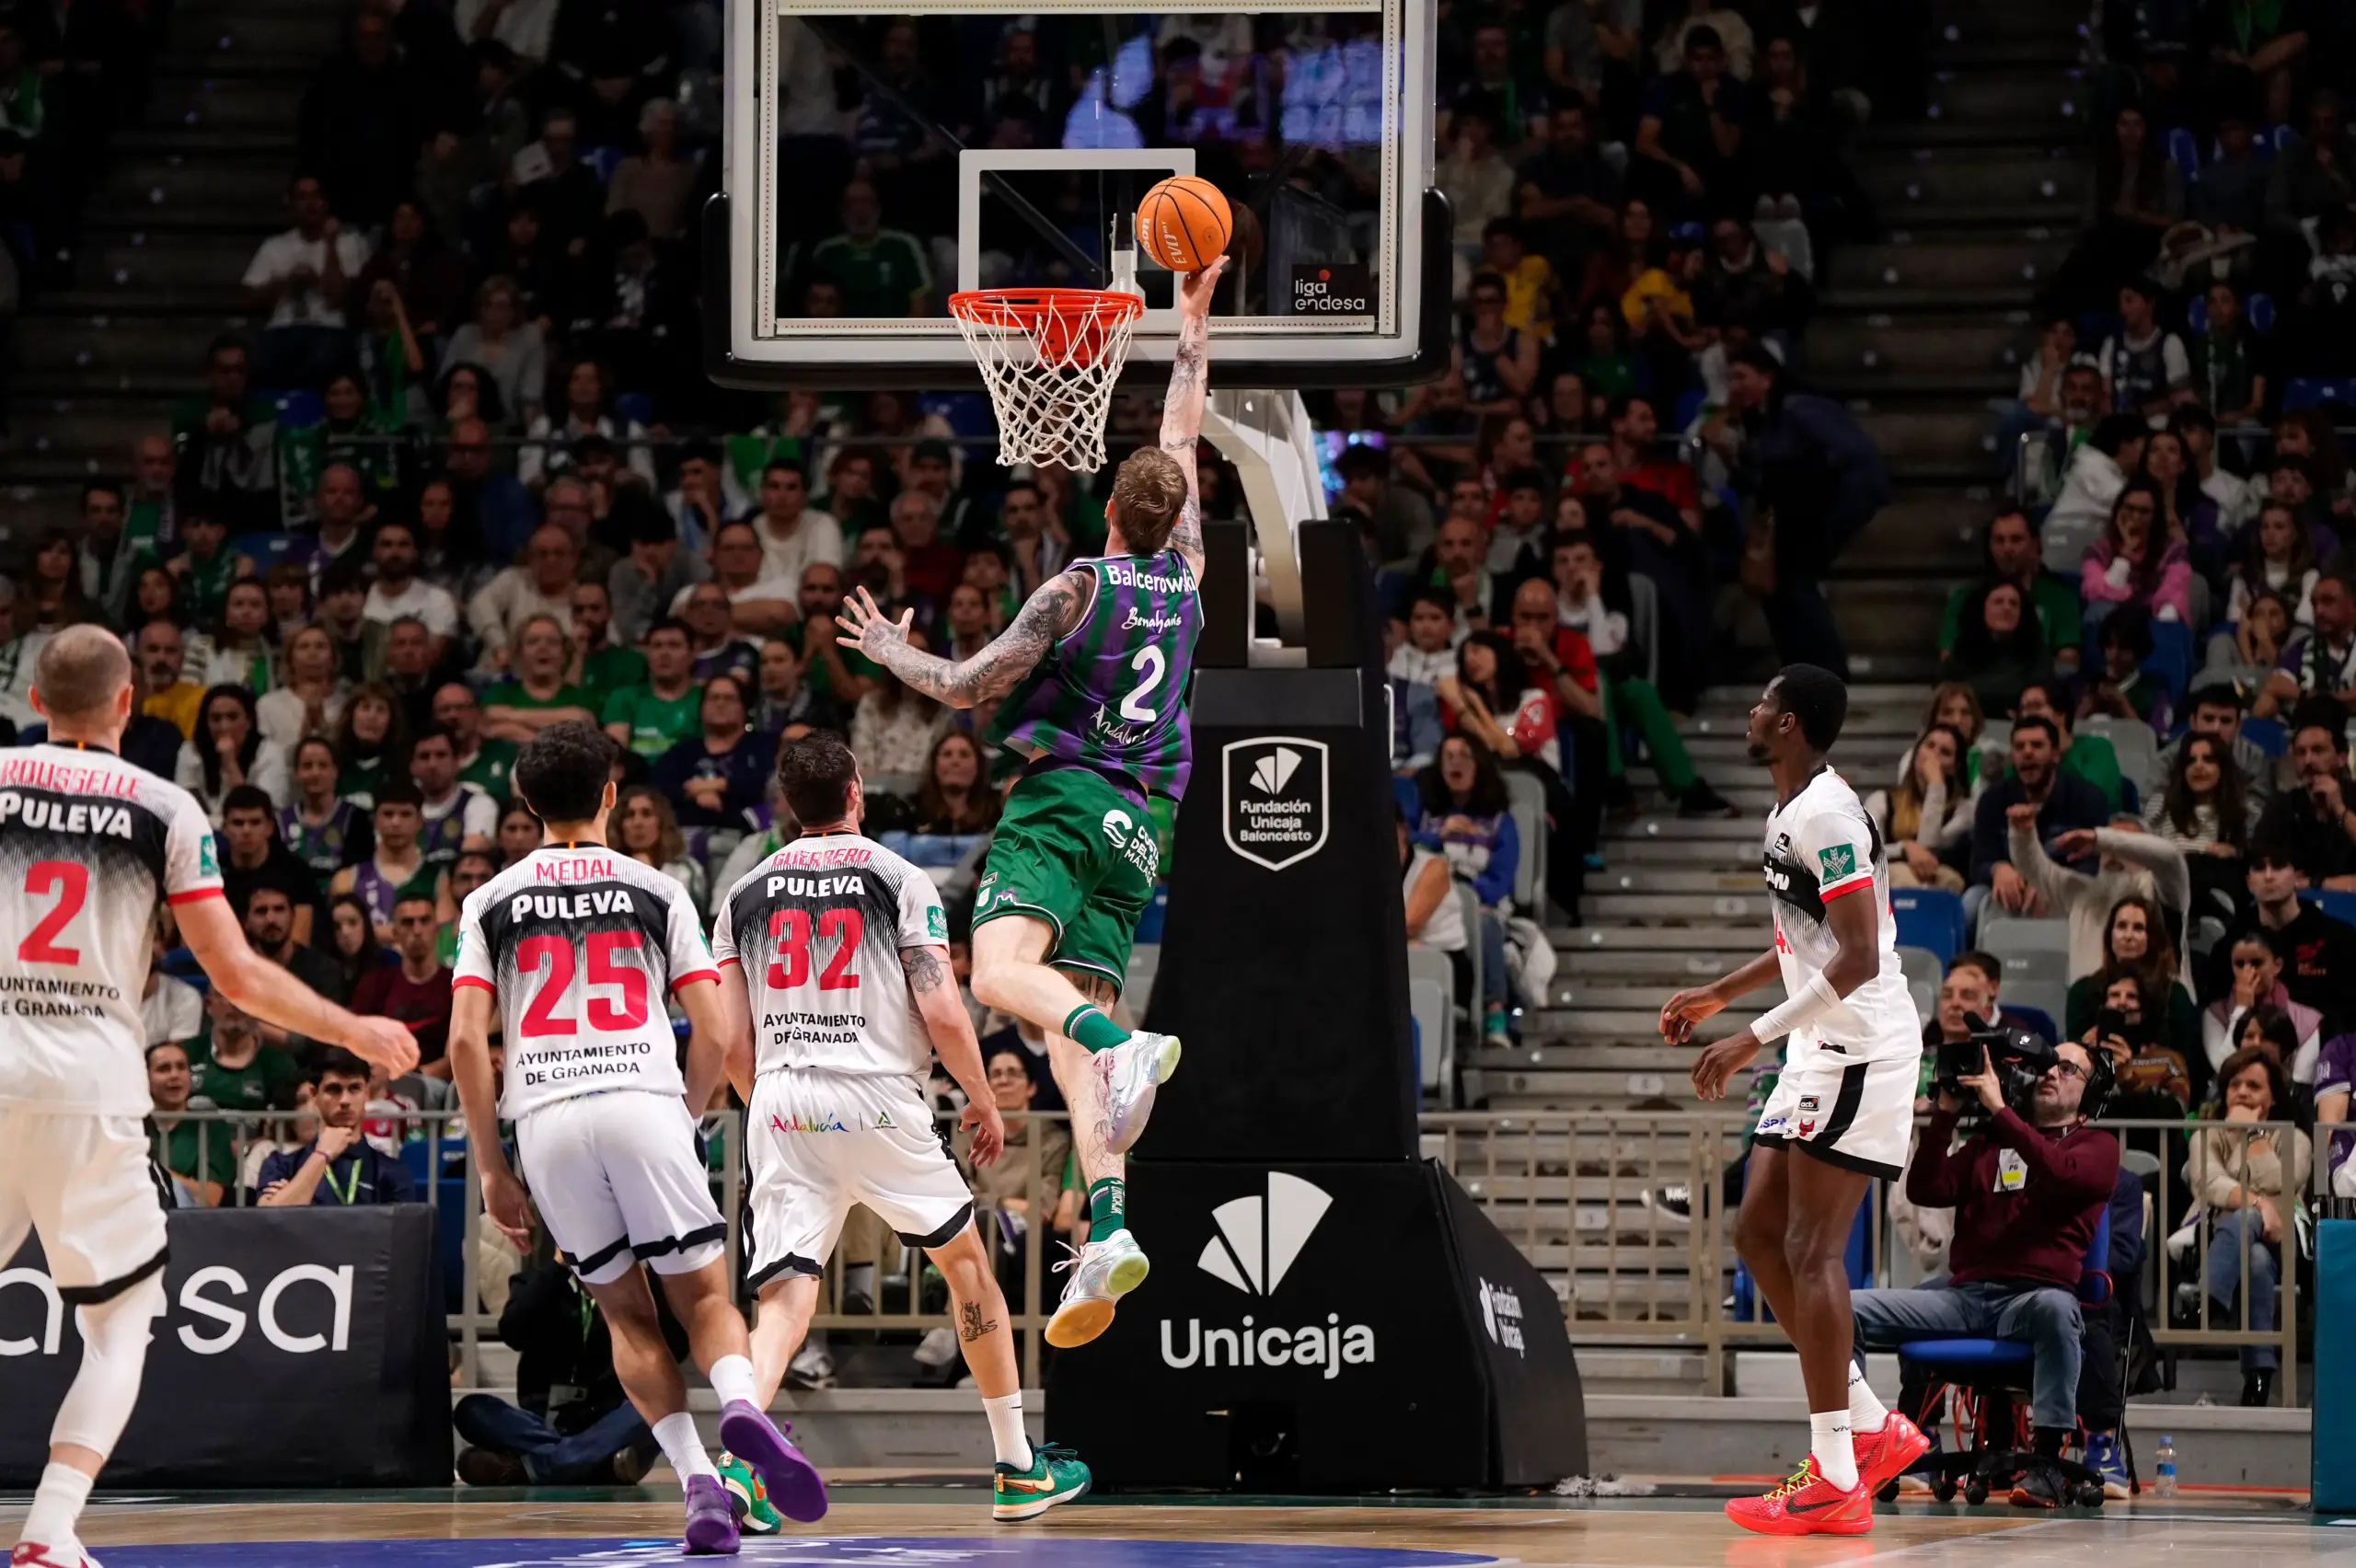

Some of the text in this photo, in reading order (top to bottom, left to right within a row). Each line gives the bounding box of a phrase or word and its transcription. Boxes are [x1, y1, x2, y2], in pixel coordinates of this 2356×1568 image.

[1295, 279, 1327, 297] liga
[1295, 295, 1365, 311] endesa
[1120, 645, 1165, 722] 2
[1, 758, 144, 801] ROUSSELLE
[0, 790, 133, 841] PULEVA
[1240, 799, 1311, 814] Fundación
[1251, 815, 1302, 831] Unicaja
[1240, 829, 1312, 842] Baloncesto
[773, 847, 872, 868] GUERRERO
[1130, 837, 1148, 860] DEL
[536, 859, 618, 882] MEDAL
[767, 874, 866, 898] PULEVA
[17, 859, 89, 966] 2
[512, 889, 634, 924] PULEVA
[767, 907, 864, 991] 32
[516, 930, 648, 1038] 25
[763, 1012, 866, 1029] AYUNTAMIENTO
[792, 1026, 860, 1043] GRANADA
[515, 1042, 651, 1068] AYUNTAMIENTO
[525, 1062, 641, 1086] DE GRANADA
[770, 1112, 850, 1133] Andalucía
[1160, 1312, 1375, 1379] Unicaja
